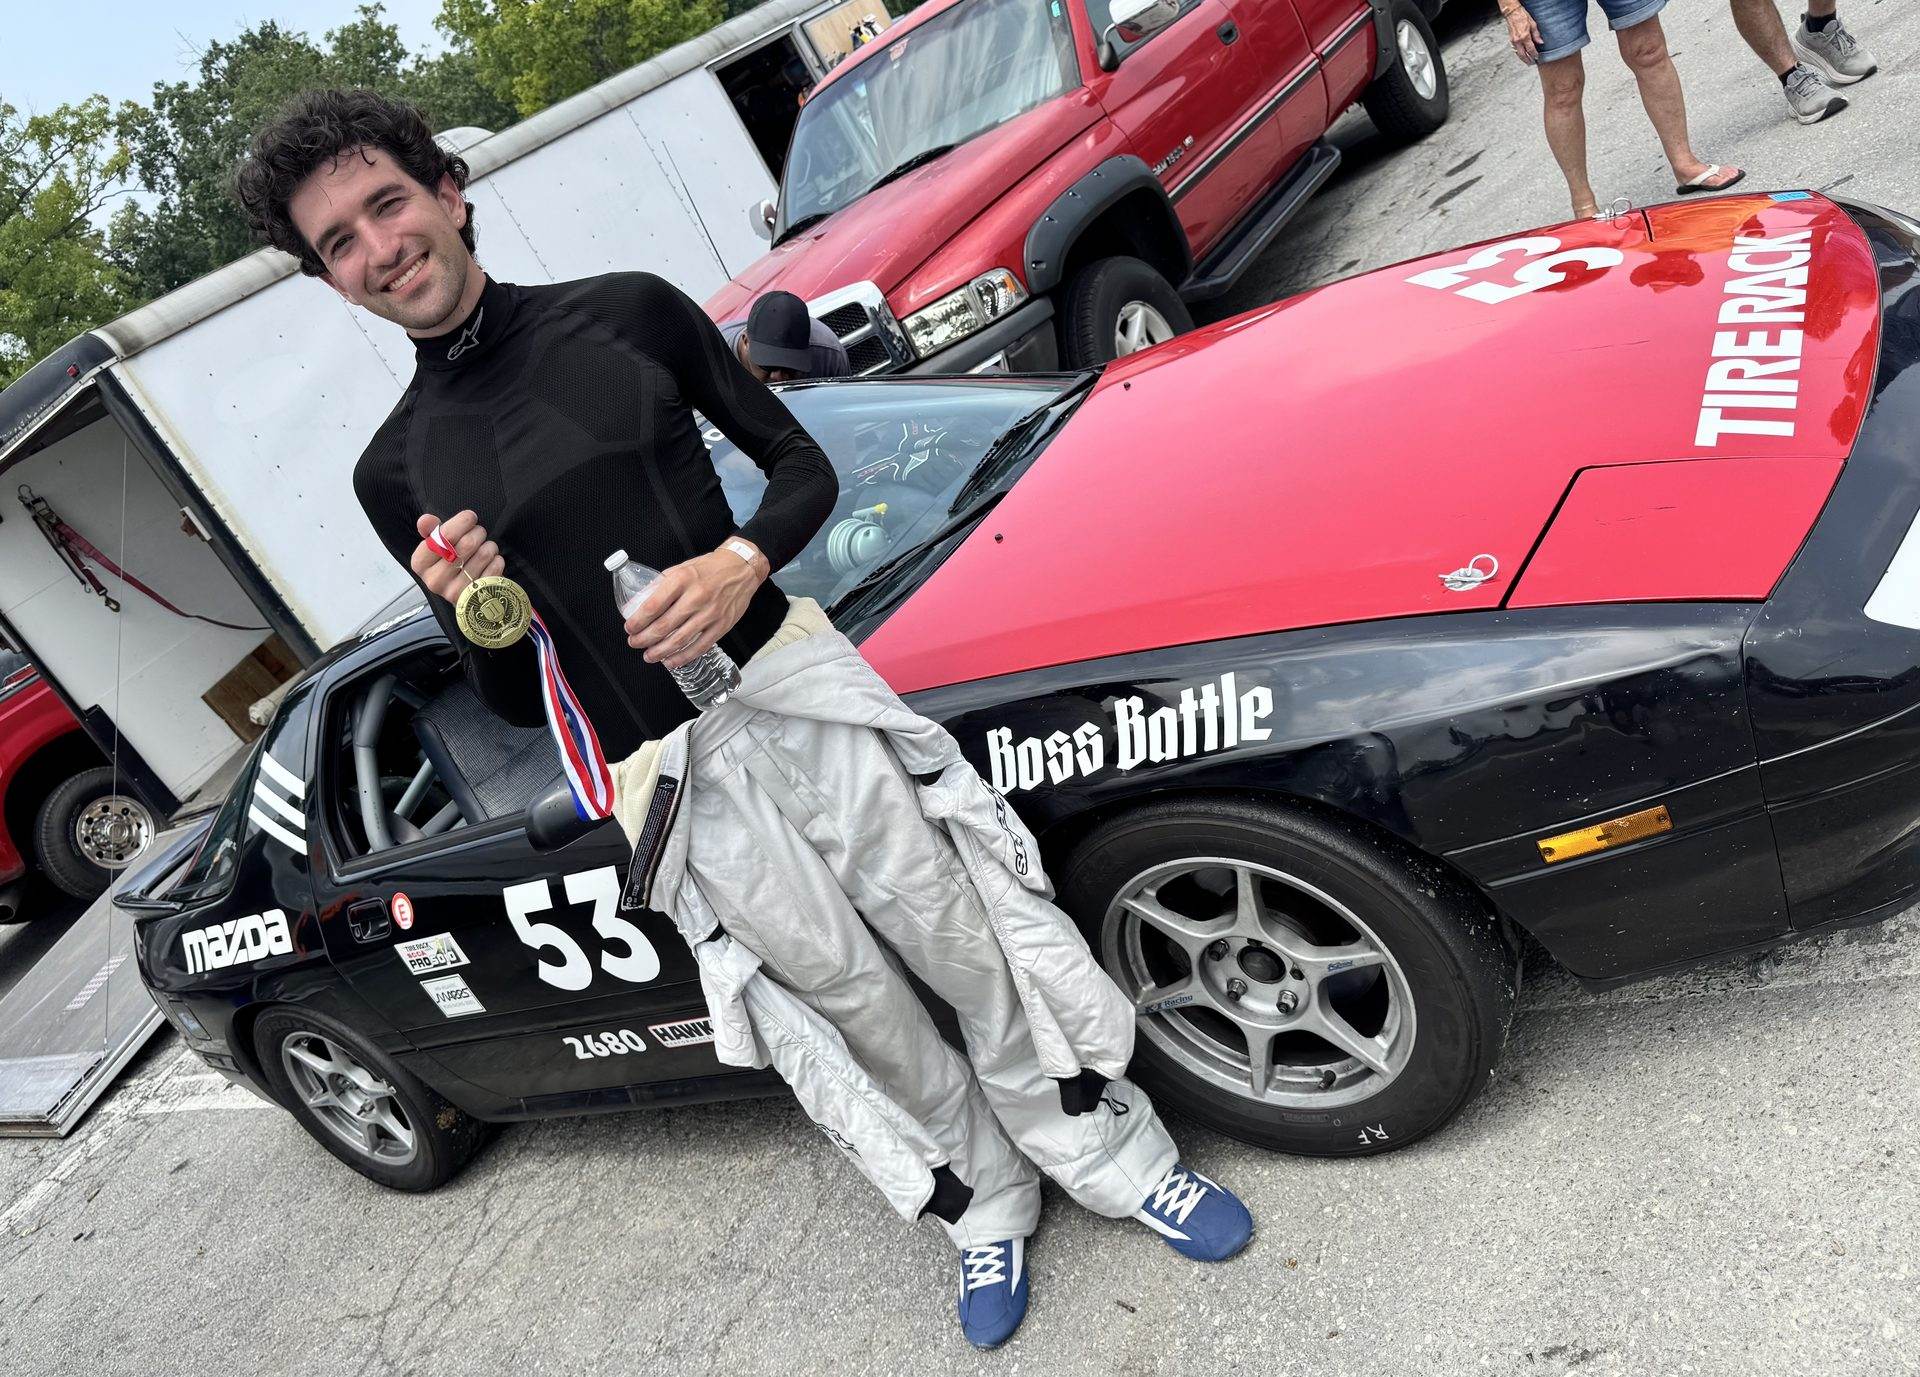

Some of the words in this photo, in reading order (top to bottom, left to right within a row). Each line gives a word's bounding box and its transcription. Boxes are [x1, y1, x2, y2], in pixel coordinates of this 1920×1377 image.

[1404, 236, 1625, 305] 53
[986, 722, 1104, 796] Boss
[1113, 671, 1275, 772] Battle
[502, 865, 661, 992] 53
[562, 1029, 648, 1061] 2680
[652, 1020, 715, 1042] HAWK
